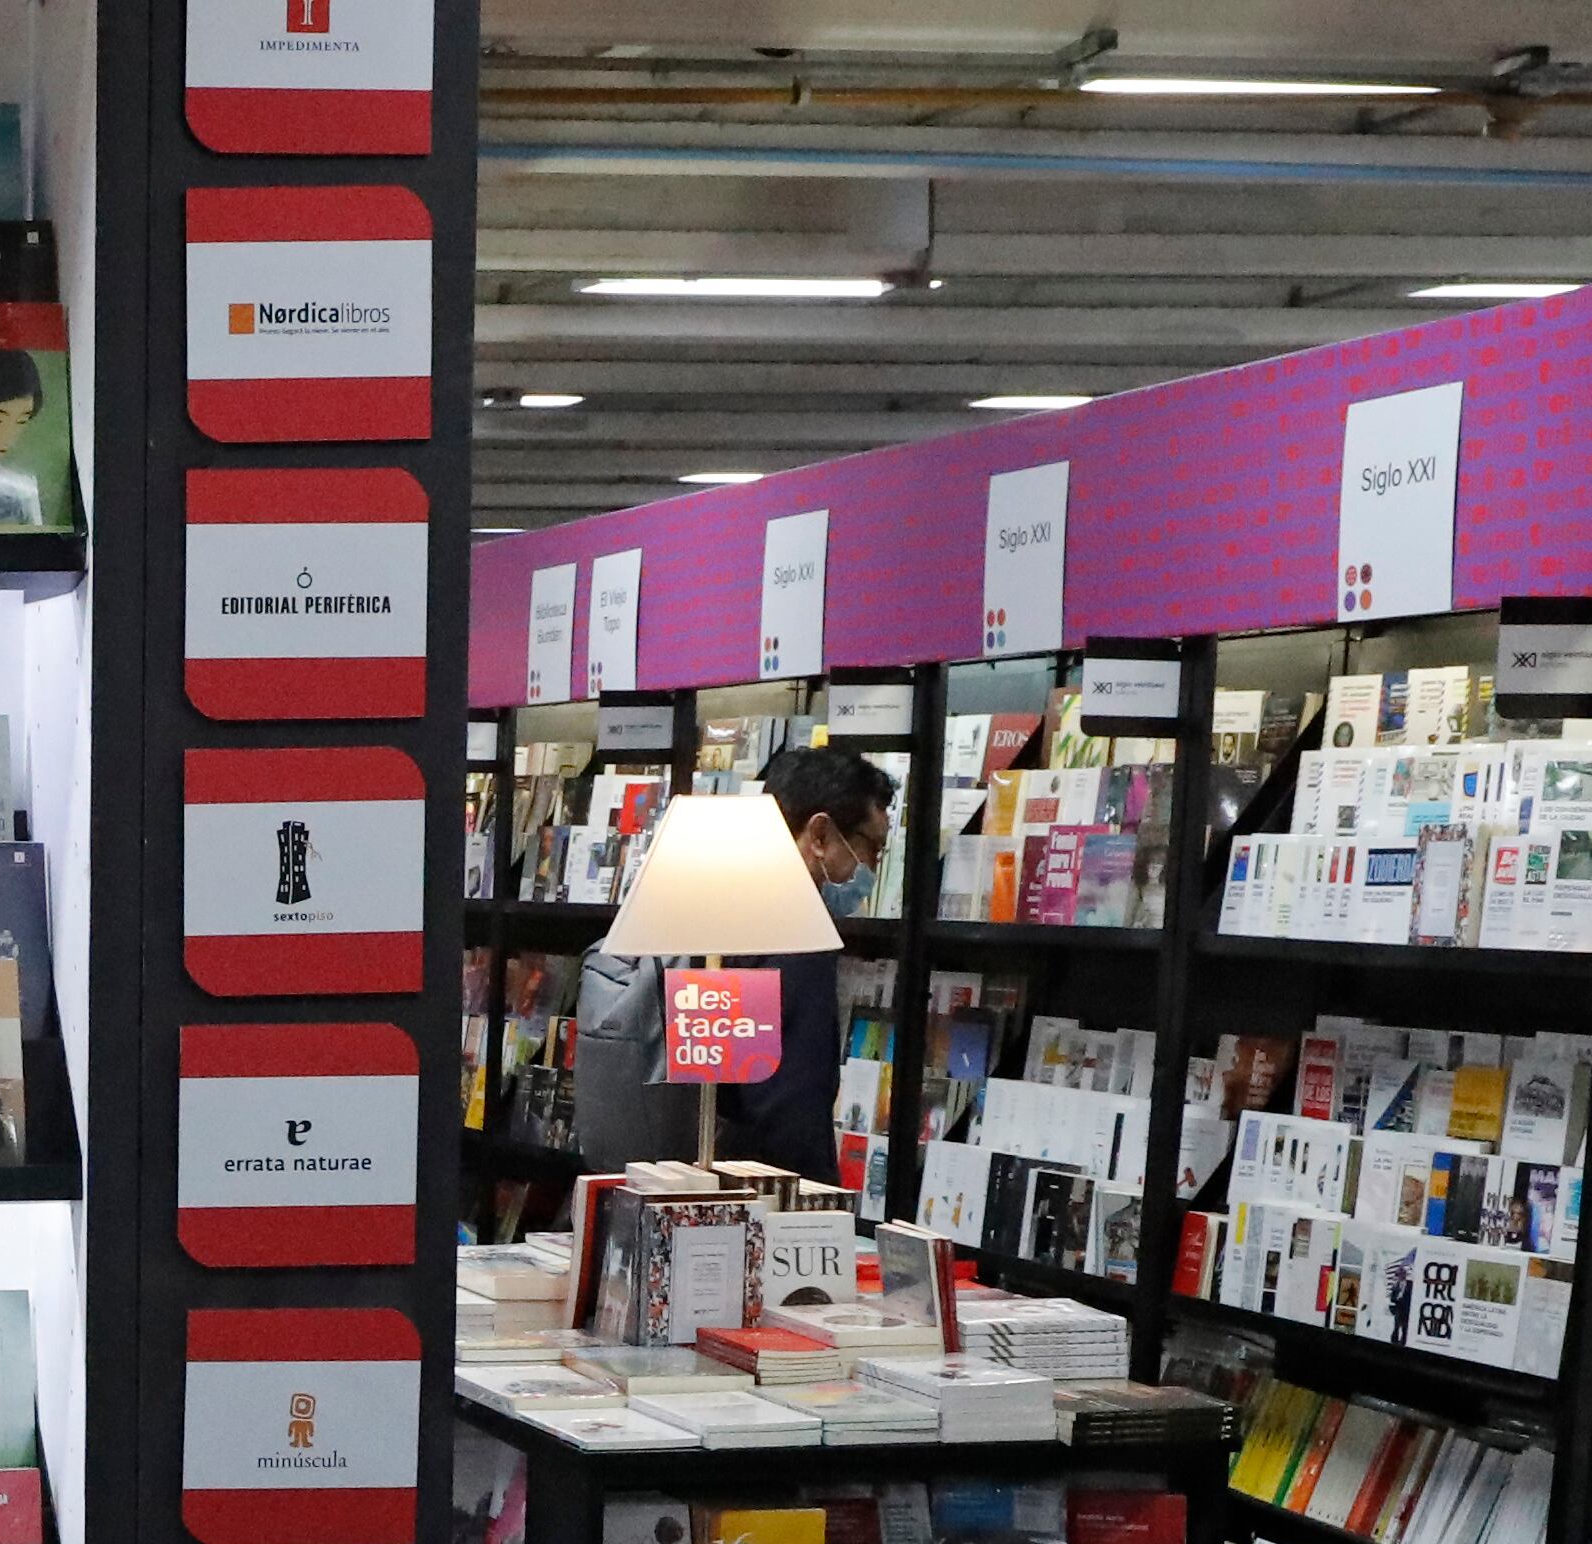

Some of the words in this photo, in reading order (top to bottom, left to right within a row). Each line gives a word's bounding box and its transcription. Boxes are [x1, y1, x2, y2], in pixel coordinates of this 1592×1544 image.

[260, 41, 360, 51] IMPEDIMENTA
[259, 302, 390, 328] Nørdicalibros
[1361, 466, 1401, 494] Siglo
[1403, 457, 1436, 484] XXI
[999, 527, 1027, 553] Siglo
[1030, 522, 1051, 543] XXI
[774, 566, 796, 587] Siglo
[799, 562, 814, 580] XXI
[221, 596, 298, 614] EDITORIAL
[305, 593, 391, 614] PERIFÉRICA
[993, 729, 1029, 748] EROS
[273, 910, 334, 923] sextopiso
[675, 984, 739, 1011] des-
[675, 1012, 773, 1038] taca-
[675, 1040, 722, 1065] dos
[224, 1156, 285, 1172] errata
[294, 1155, 372, 1171] naturae
[772, 1245, 842, 1277] SUR
[257, 1451, 348, 1469] minúscula
